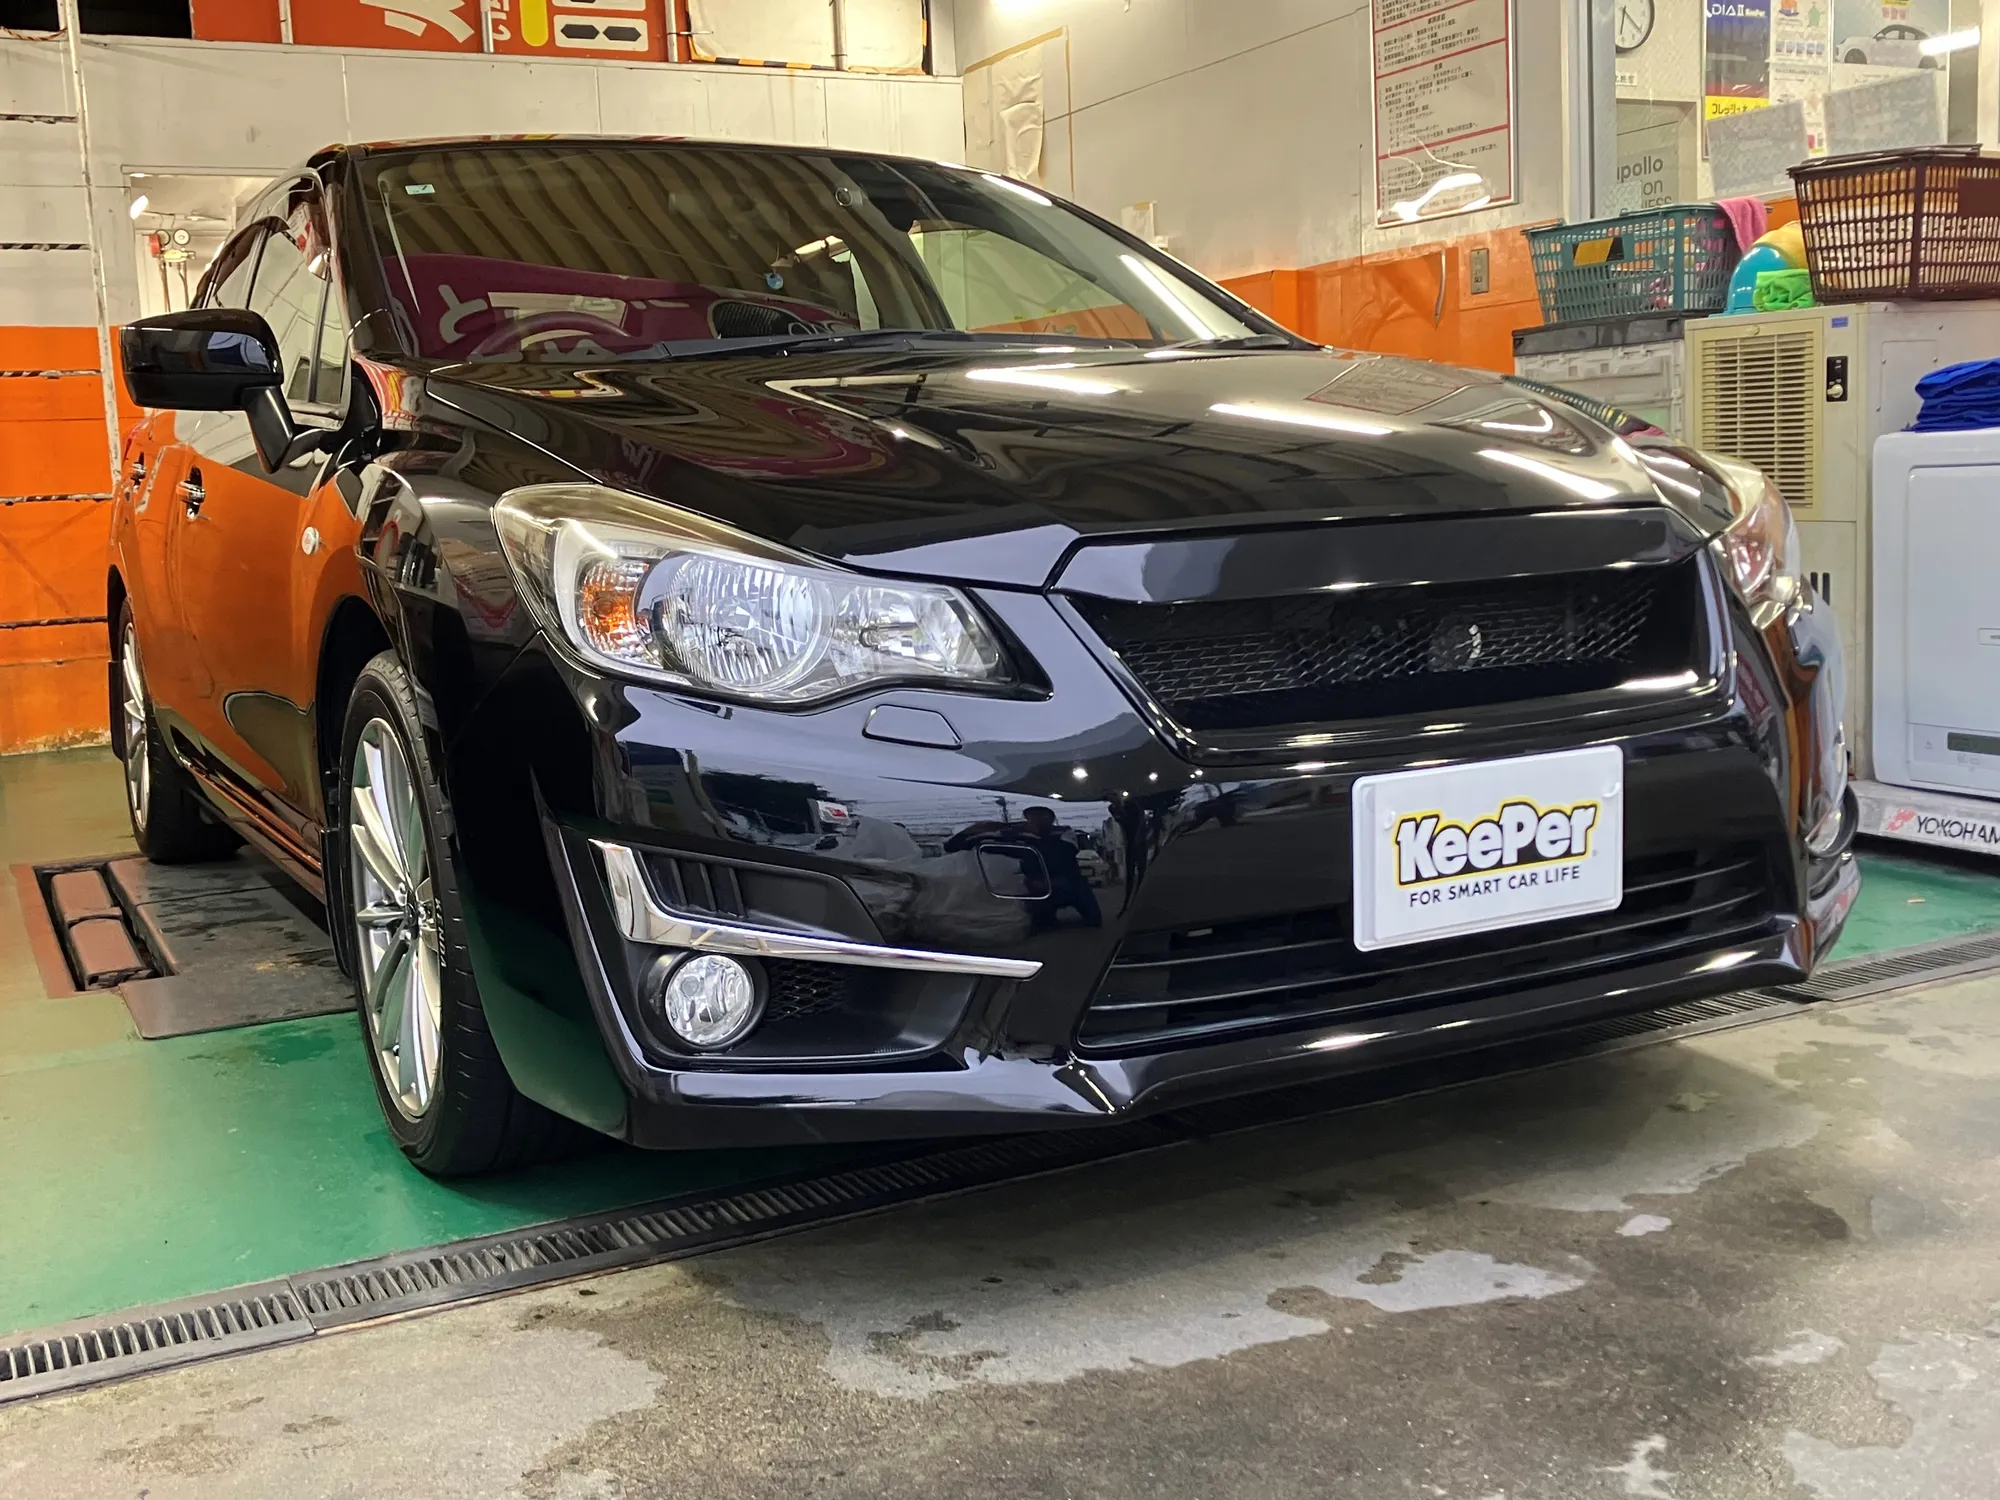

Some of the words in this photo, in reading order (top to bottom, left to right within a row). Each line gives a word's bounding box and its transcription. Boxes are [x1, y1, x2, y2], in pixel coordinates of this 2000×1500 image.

[1396, 801, 1597, 885] KeePer
[1410, 889, 1441, 907] FOR
[1448, 878, 1502, 901] SMART
[1508, 873, 1539, 890] CAR
[1545, 865, 1580, 884] LIFE
[435, 897, 447, 968] KENDA
